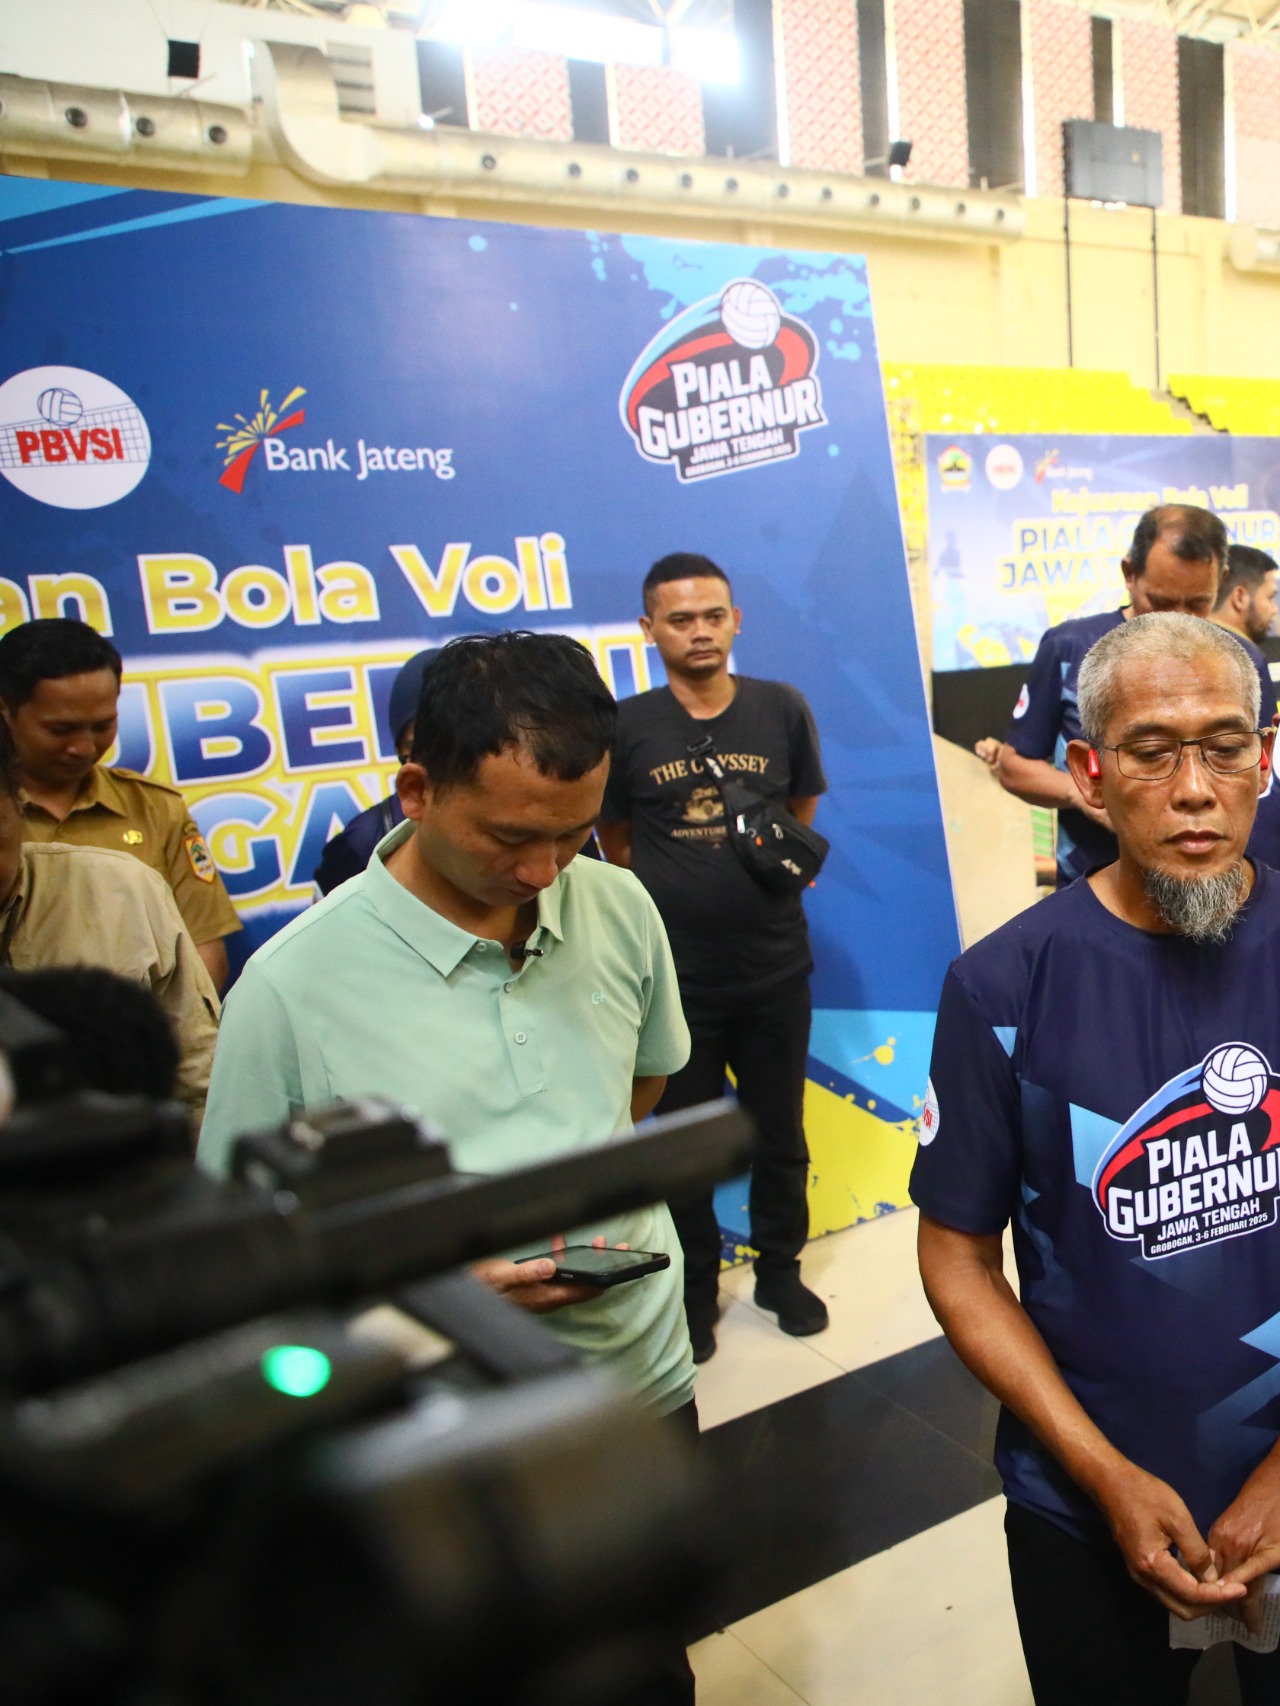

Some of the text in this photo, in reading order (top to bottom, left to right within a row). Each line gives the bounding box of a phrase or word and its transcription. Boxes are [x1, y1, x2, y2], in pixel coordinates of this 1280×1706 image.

[671, 354, 773, 408] PIALA
[638, 378, 820, 457] GUBERNUR
[16, 427, 124, 463] PBVSI
[263, 438, 456, 480] Bank Jateng
[690, 440, 731, 464] JAWA
[731, 427, 785, 456] TENGAH
[1020, 526, 1113, 553] PIALA
[138, 544, 380, 635] Bola
[389, 531, 573, 618] Voli
[1003, 558, 1096, 589] JAWA
[649, 758, 688, 786] THE
[690, 753, 770, 774] OYSSEY
[1146, 1121, 1253, 1185] PIALA
[1157, 1197, 1261, 1241] JAWA TENGAH
[1195, 1230, 1210, 1243] 3-6
[1210, 1219, 1248, 1238] FEBRUARI
[1248, 1212, 1269, 1227] 2025
